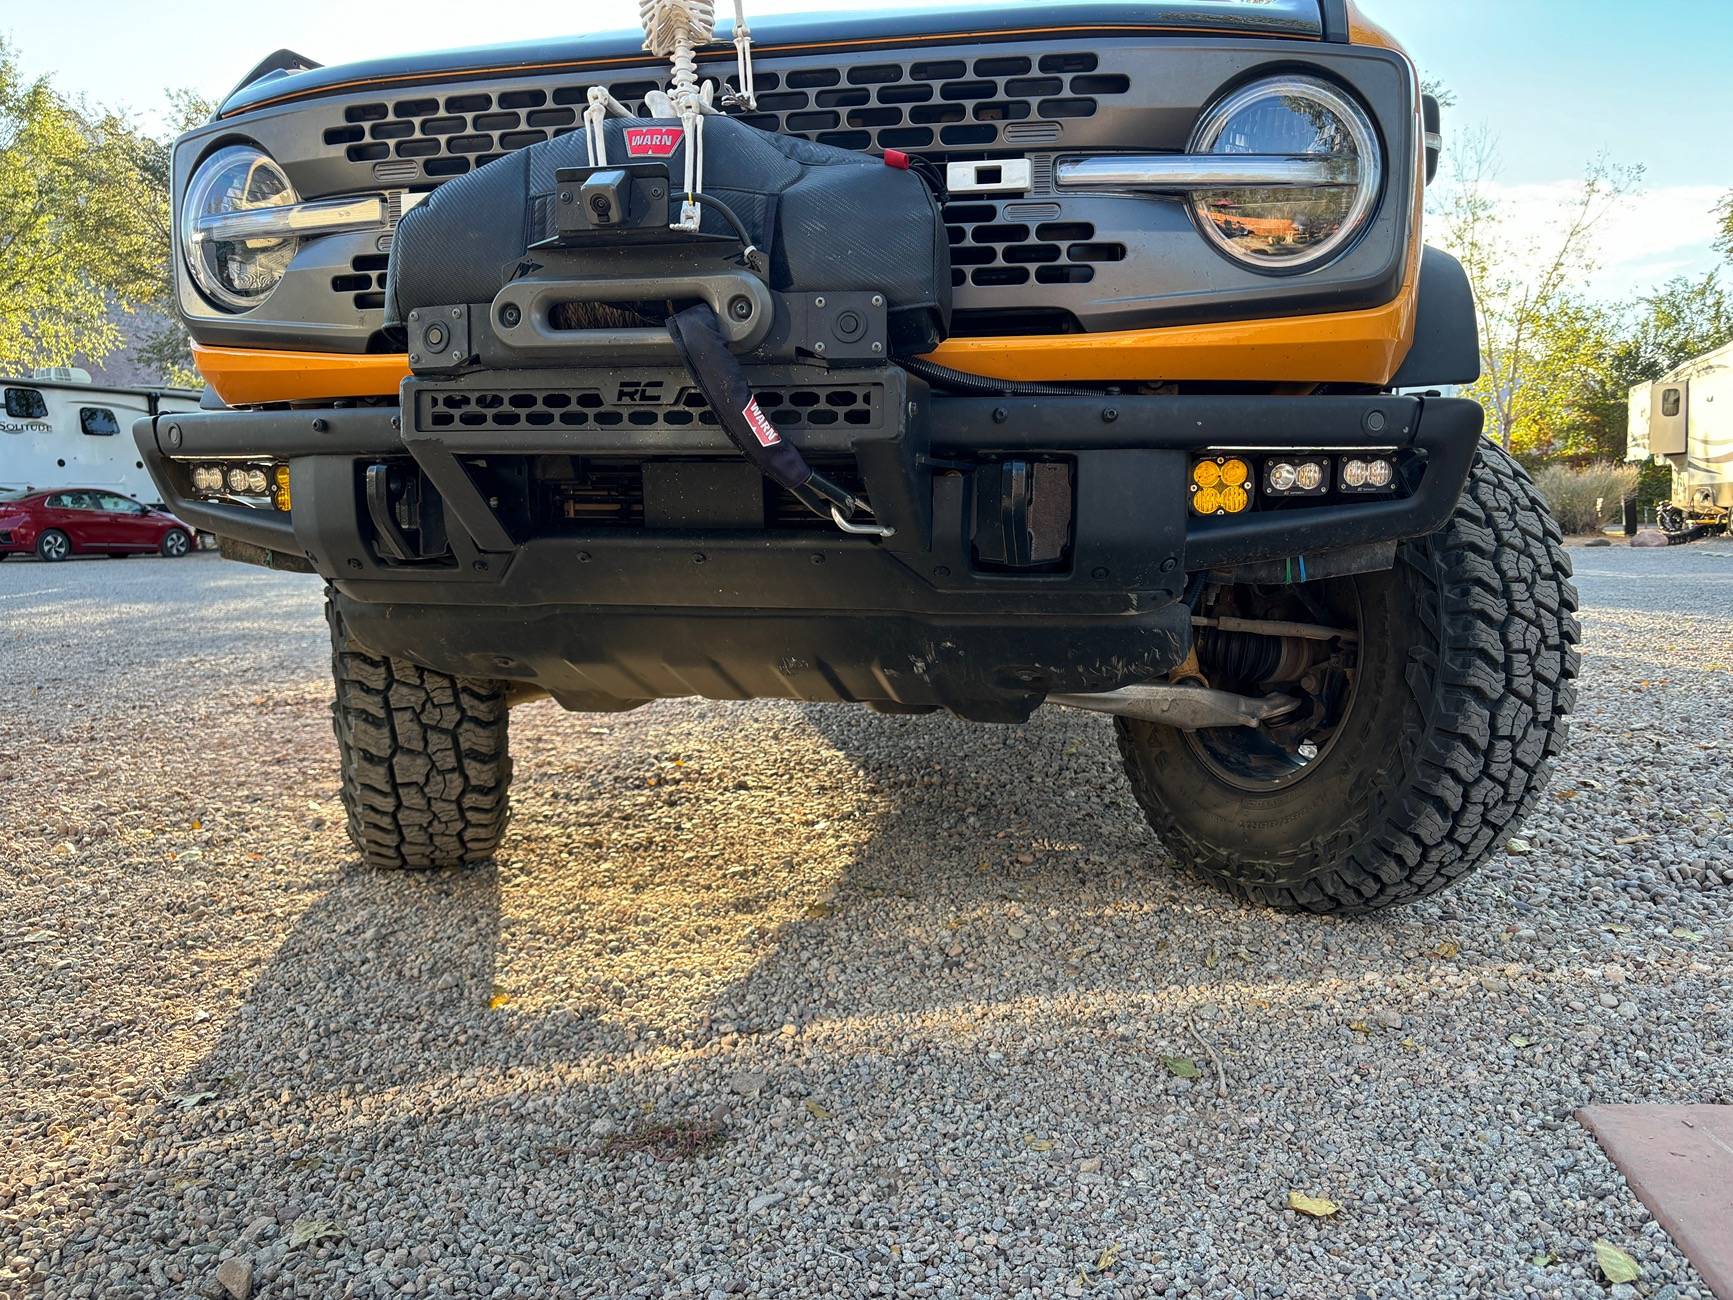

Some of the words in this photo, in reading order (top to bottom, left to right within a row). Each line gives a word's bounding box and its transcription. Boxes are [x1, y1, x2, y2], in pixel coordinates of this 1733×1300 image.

[631, 134, 673, 146] WARN
[617, 381, 664, 402] RC
[750, 401, 779, 441] WARN
